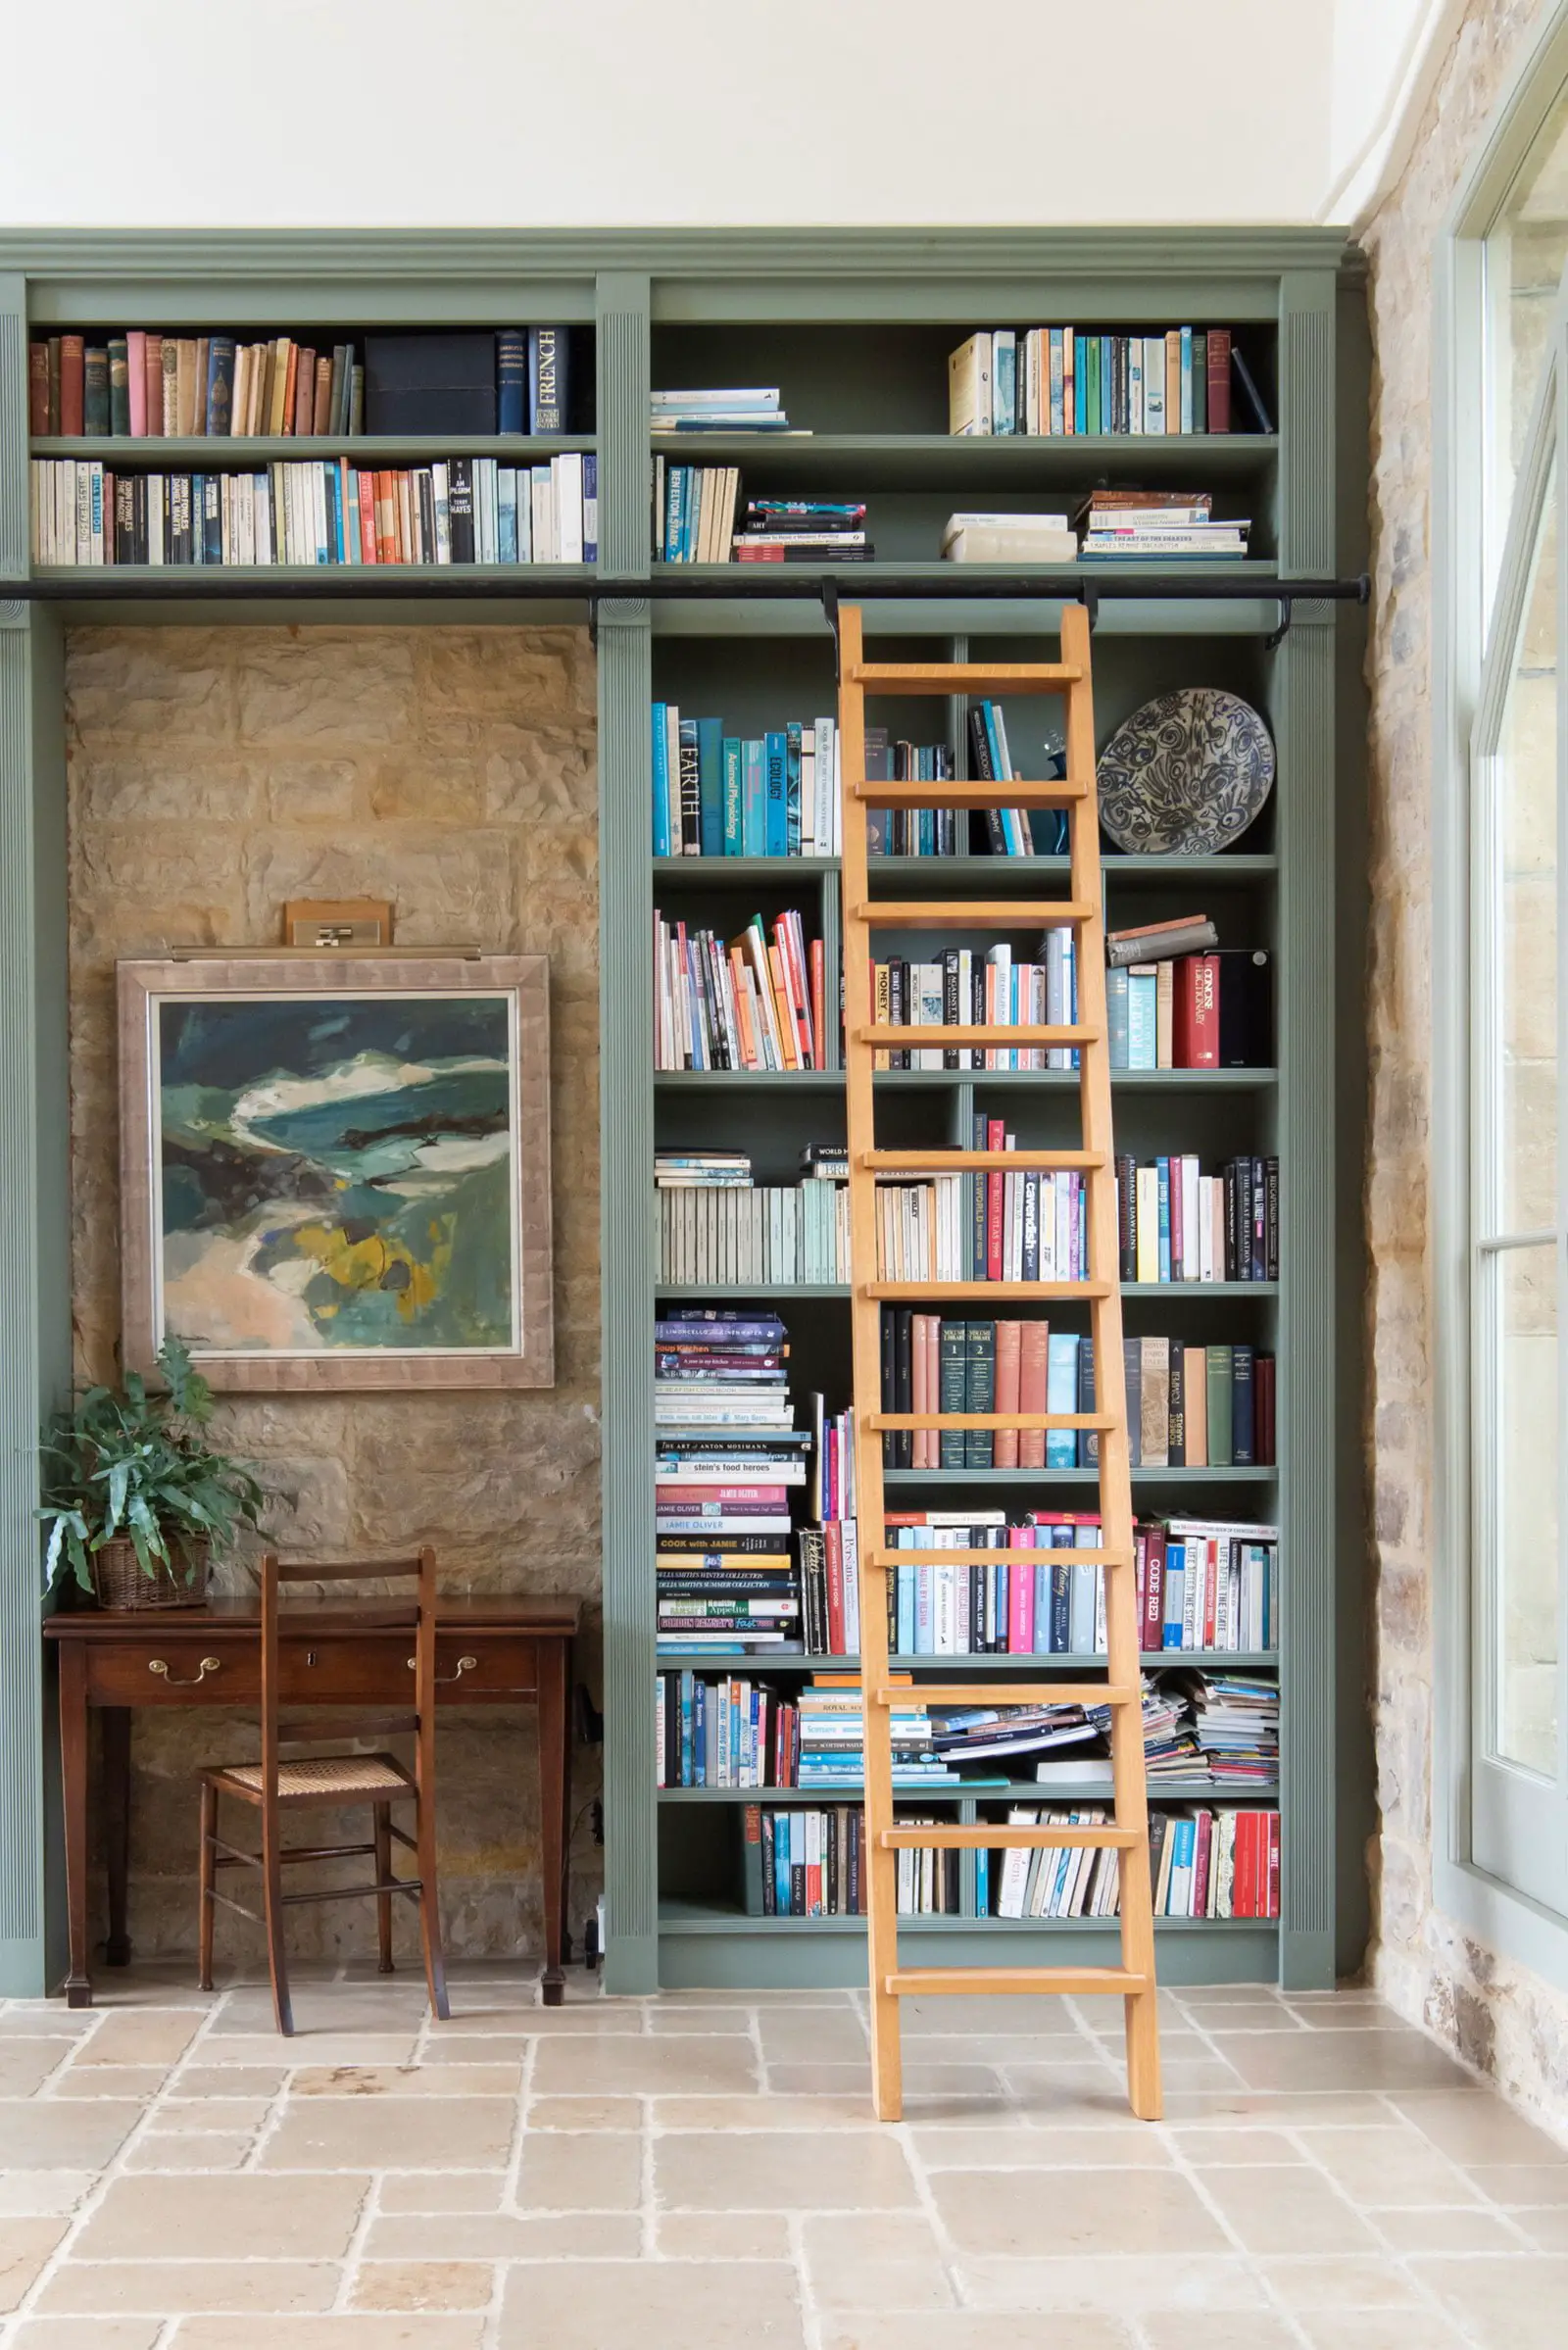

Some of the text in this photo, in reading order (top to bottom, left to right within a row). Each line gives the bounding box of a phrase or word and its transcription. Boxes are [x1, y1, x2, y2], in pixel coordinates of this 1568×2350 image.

[539, 330, 556, 405] FRENCH
[124, 480, 133, 532] JOHN FOWLES
[180, 478, 189, 530] JOHN FOWLES
[452, 505, 470, 514] HAYES
[671, 470, 682, 547] BEN ELTON STARK
[976, 737, 986, 750] THE
[978, 751, 989, 769] BOOK
[681, 748, 700, 815] EARTH
[727, 753, 739, 840] Animal Physiology
[770, 758, 783, 801] ECOLOGY
[1195, 969, 1203, 1026] DICTIONARY
[1203, 968, 1213, 1010] CONCISE
[1025, 1182, 1037, 1250] cavendish
[1157, 1182, 1169, 1227] jump point
[1254, 1188, 1264, 1221] WALL STREET
[676, 1344, 709, 1352] Kitchen
[952, 1345, 957, 1354] 1
[977, 1345, 984, 1355] 2
[1171, 1371, 1180, 1404] POMPEII
[719, 1490, 736, 1498] JAMIE
[808, 1536, 824, 1576] Delia
[845, 1538, 856, 1584] Persiana
[1187, 1546, 1196, 1564] LIFE
[1149, 1559, 1160, 1621] CODE RED
[1187, 1566, 1196, 1591] AFTER
[1217, 1546, 1228, 1632] LIFE AFTER THE STATE
[710, 1606, 748, 1616] Appetite
[735, 1618, 756, 1629] fast
[919, 1590, 928, 1626] BY DESIGN
[958, 1586, 968, 1640] MISCALCULATES
